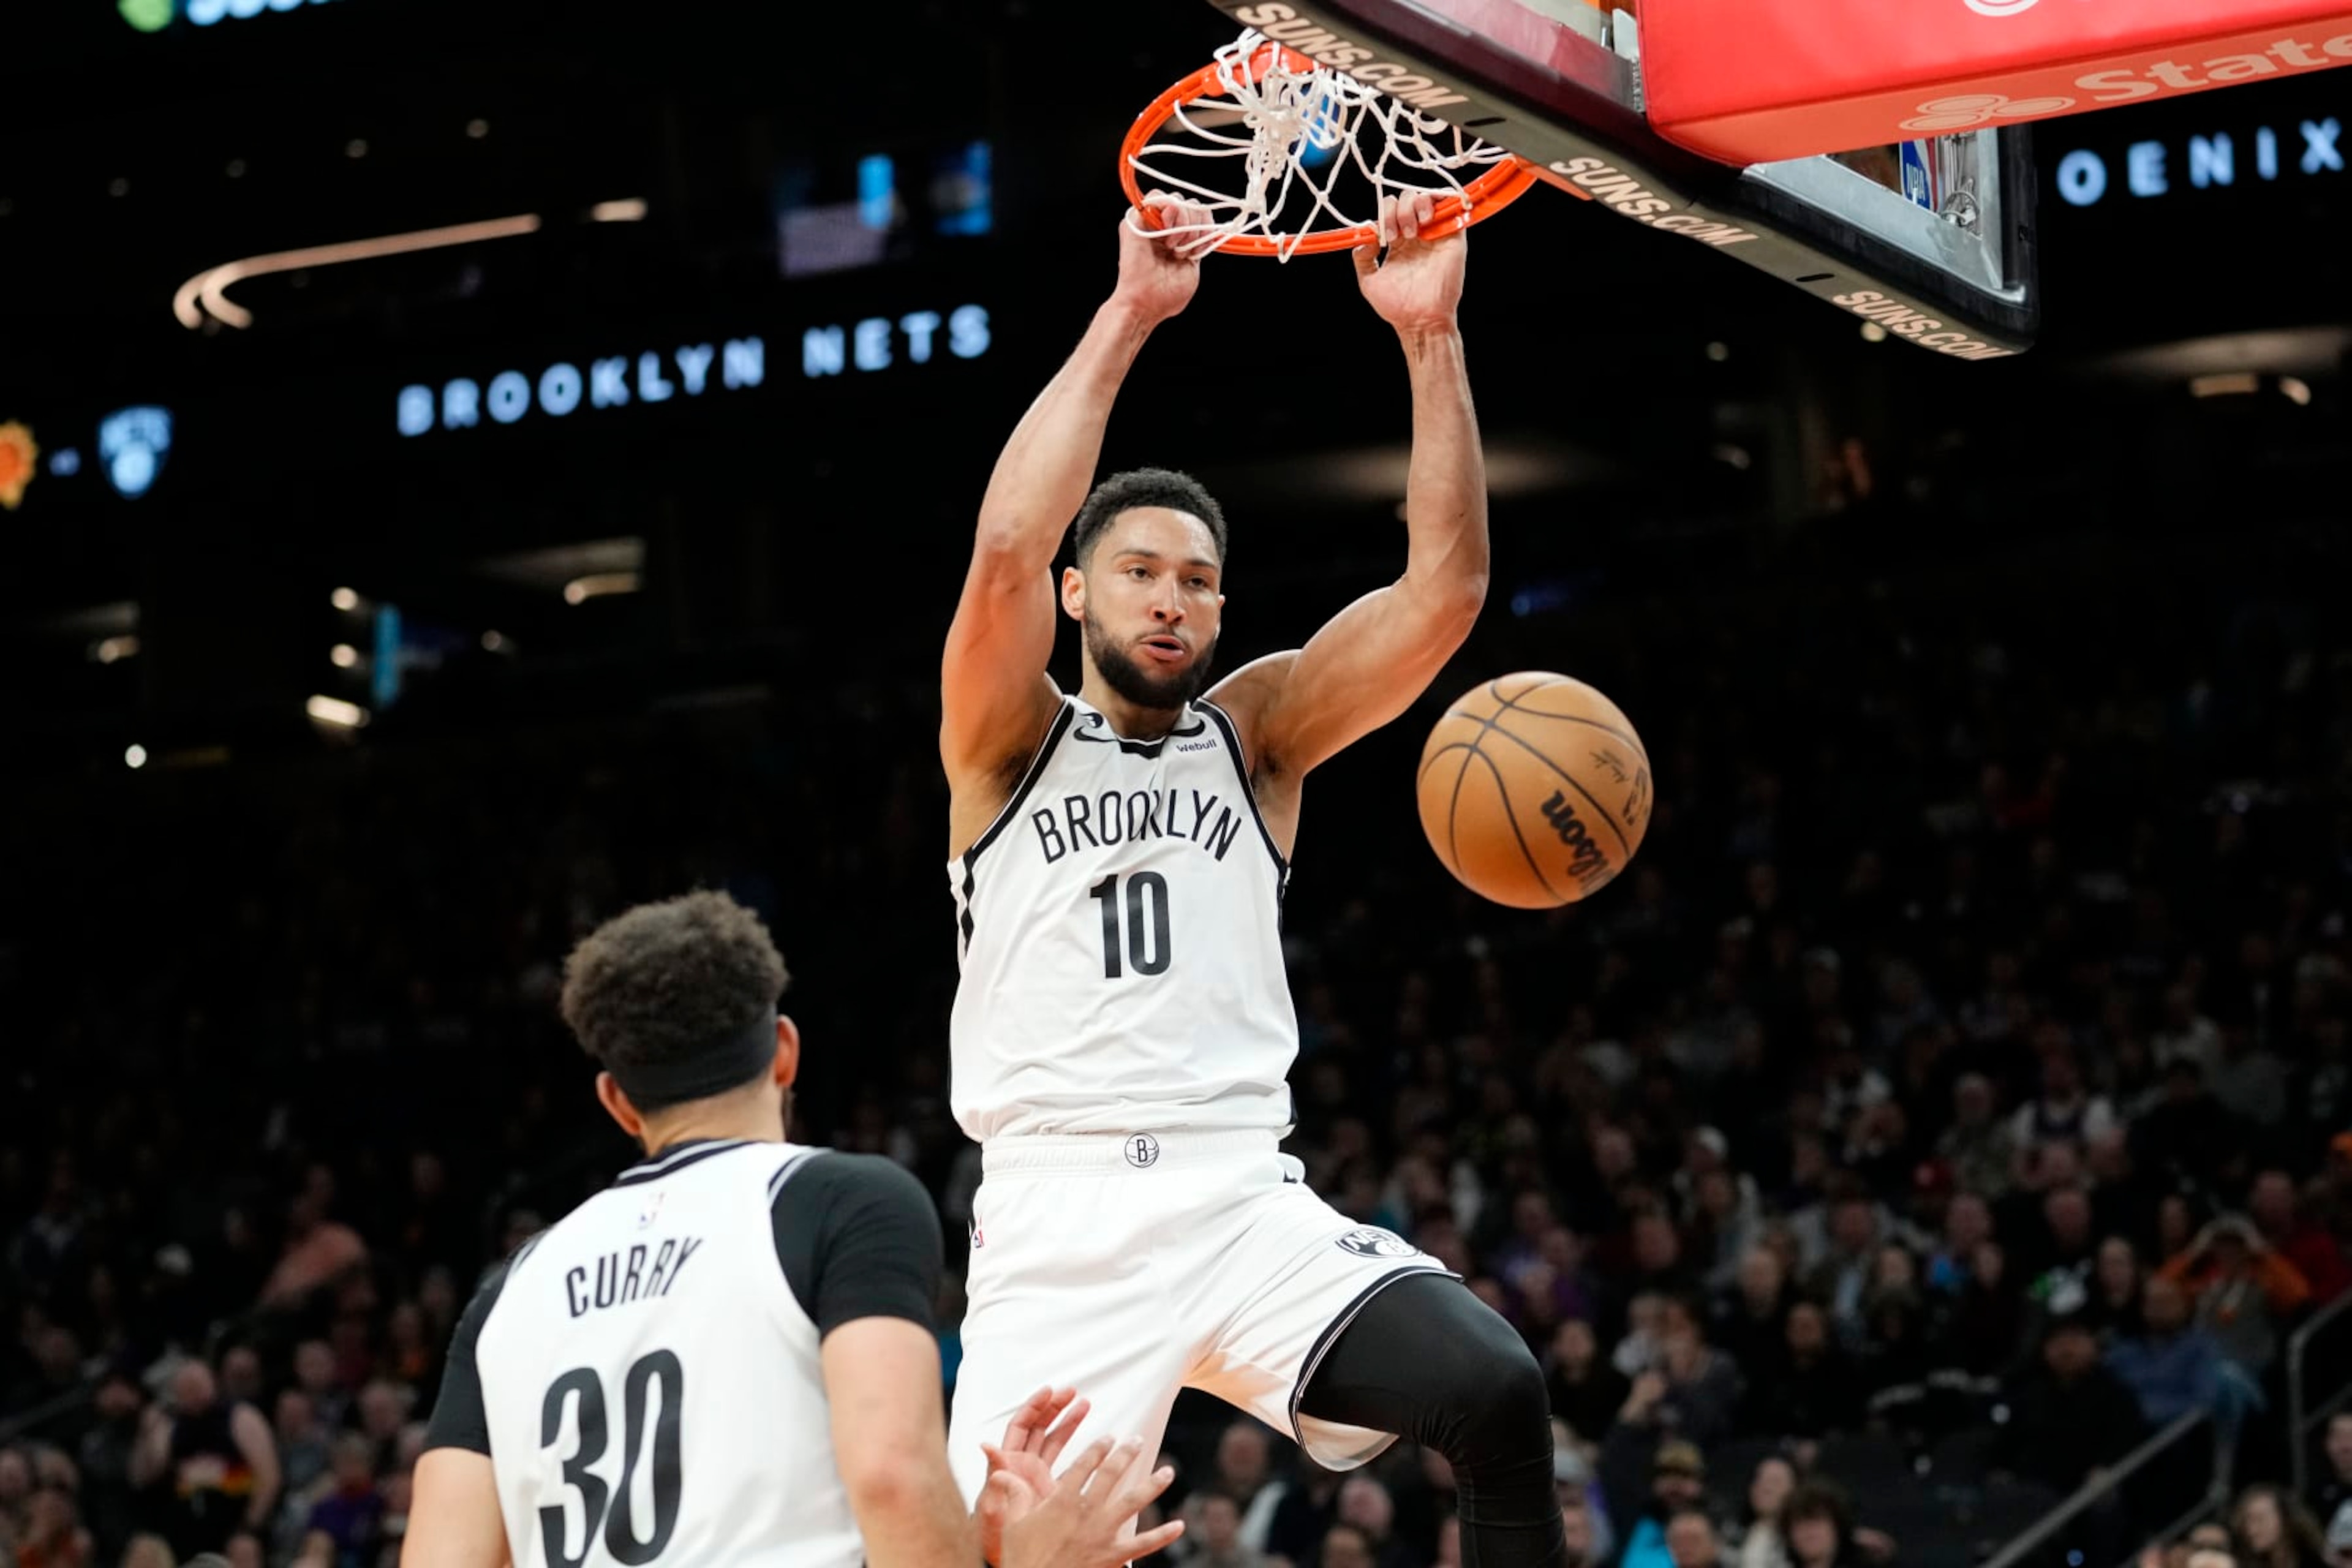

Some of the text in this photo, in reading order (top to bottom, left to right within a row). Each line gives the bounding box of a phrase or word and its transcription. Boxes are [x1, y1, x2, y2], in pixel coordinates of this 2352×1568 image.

[1236, 2, 1469, 109] SUNS.COM
[1549, 157, 1758, 246] SUNS.COM
[1833, 291, 2015, 361] SUNS.COM
[397, 304, 991, 437] BROOKLYN NETS
[1176, 739, 1217, 752] Webull
[1032, 789, 1242, 864] BROOKLYN
[1090, 871, 1171, 978] 10
[1137, 1139, 1148, 1162] B
[565, 1237, 704, 1319] CURRY
[539, 1349, 684, 1568] 30
